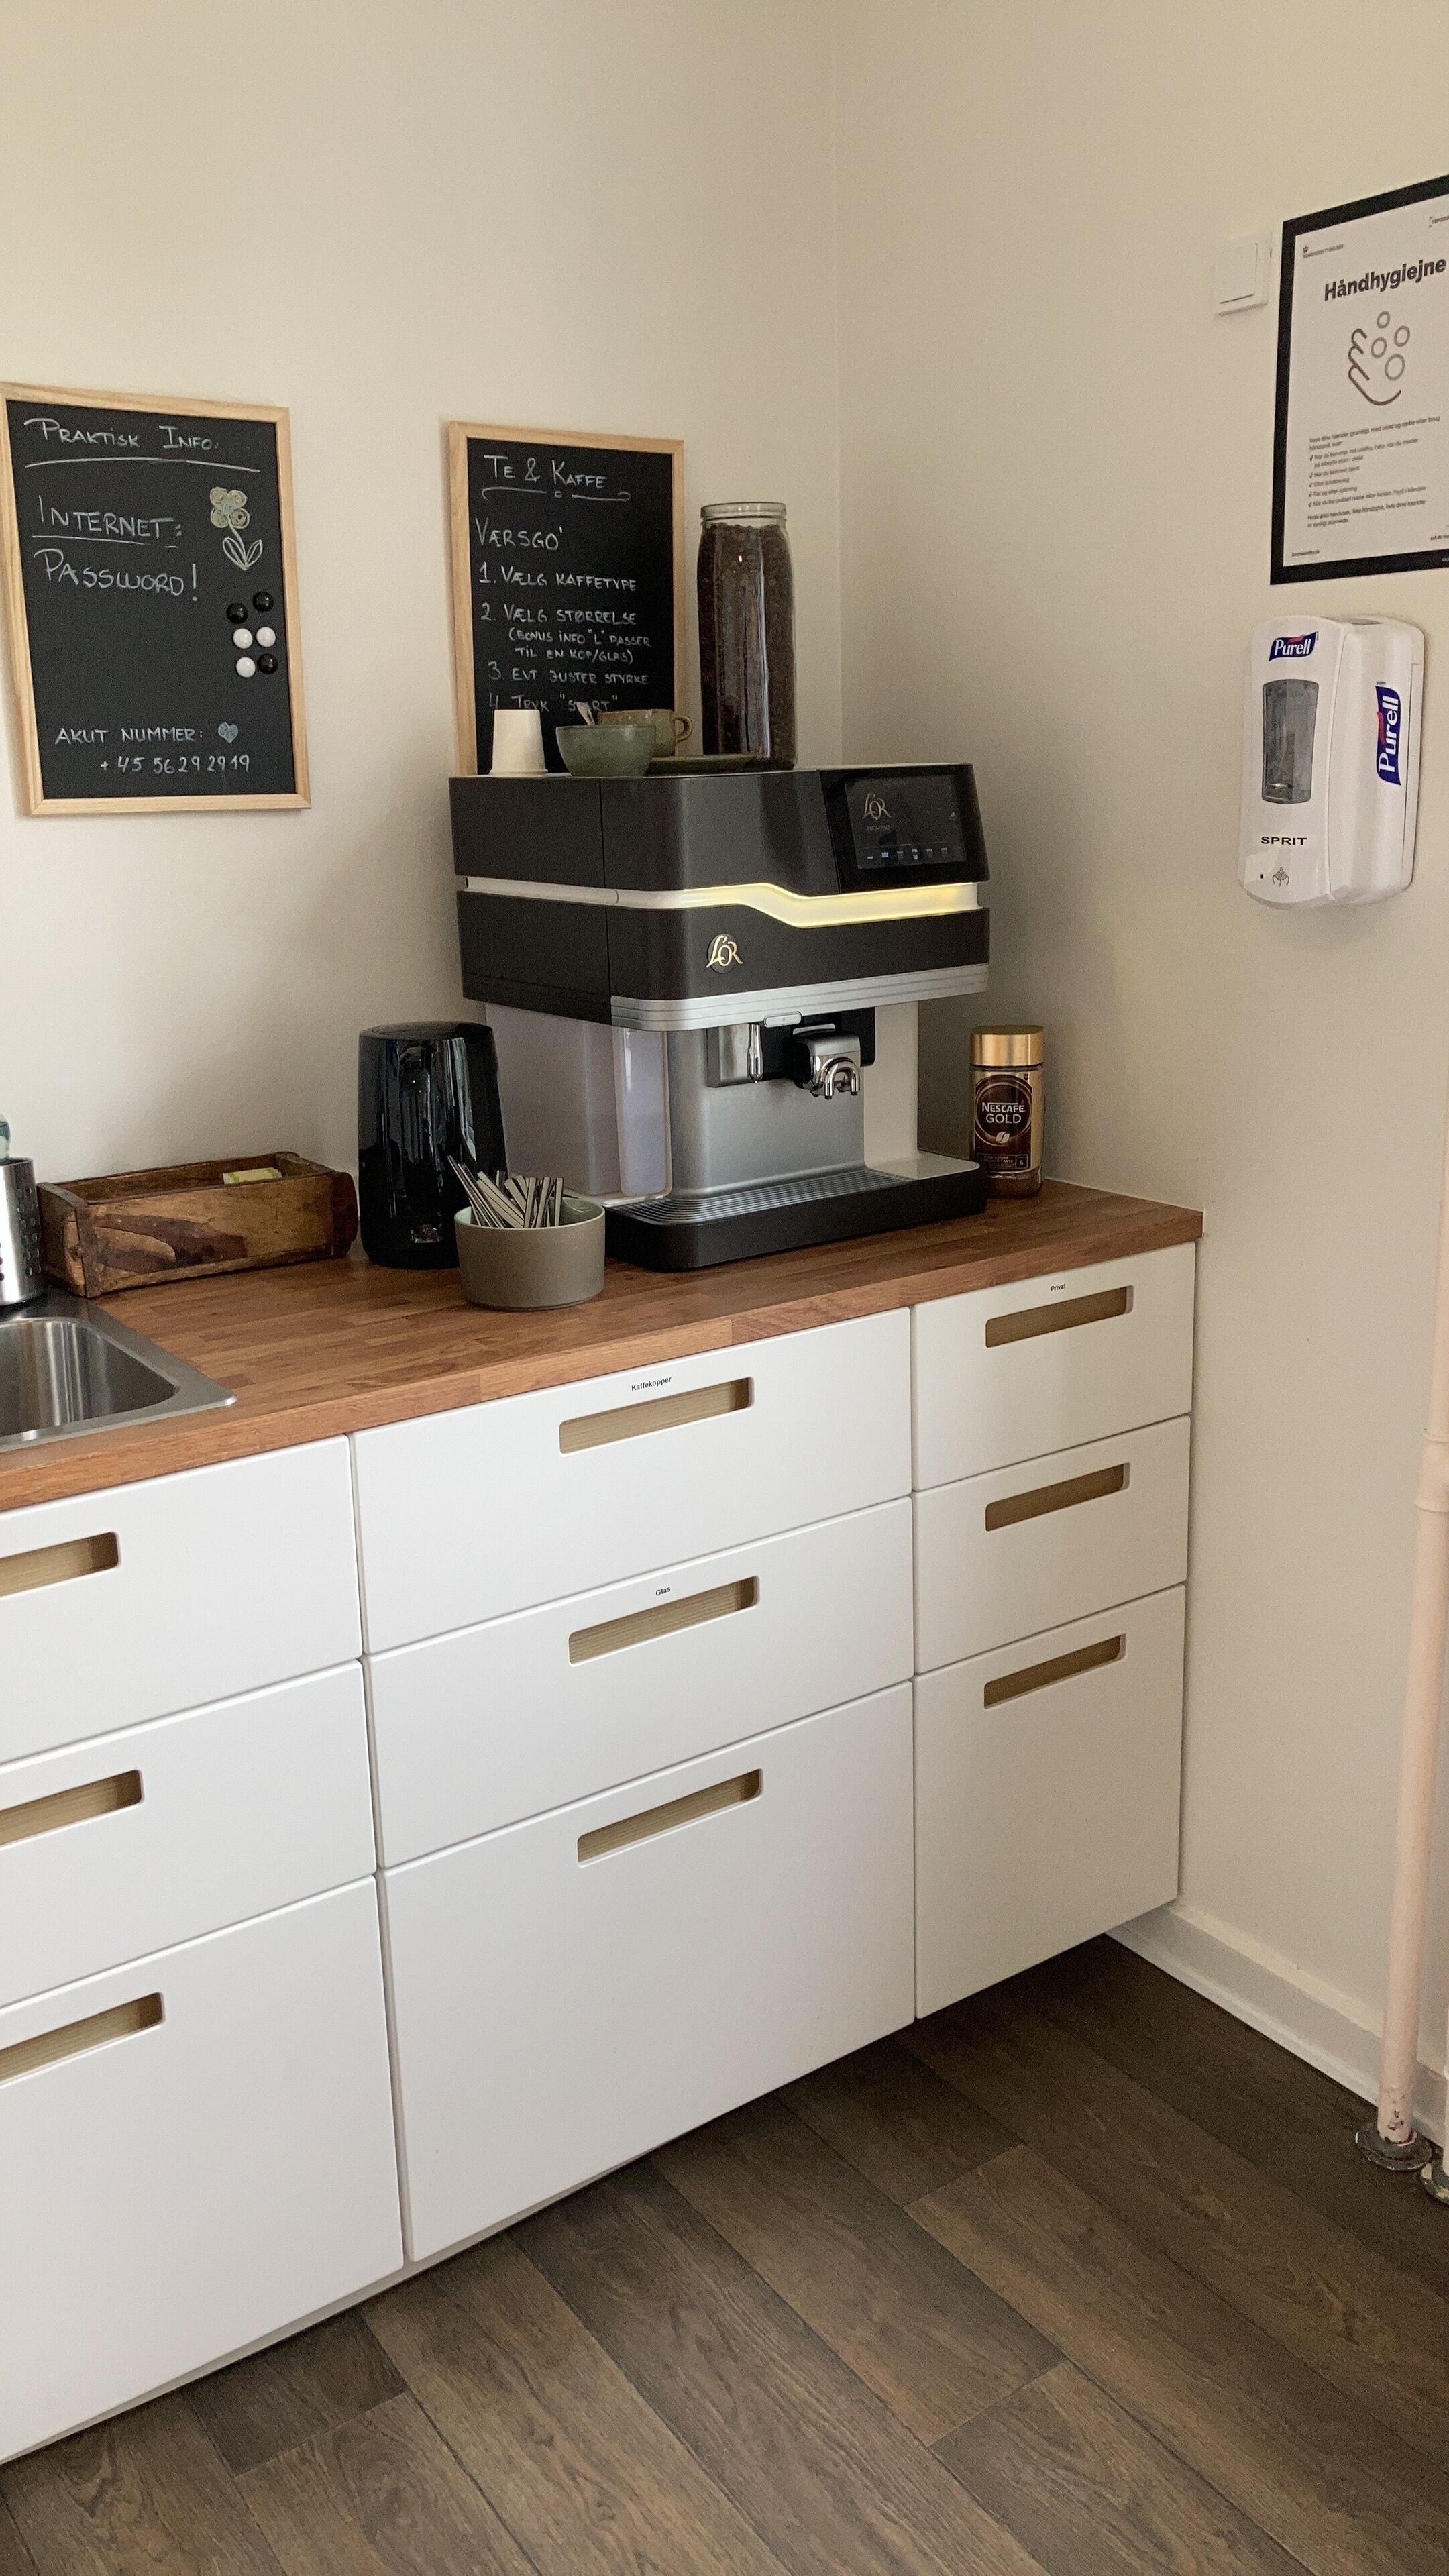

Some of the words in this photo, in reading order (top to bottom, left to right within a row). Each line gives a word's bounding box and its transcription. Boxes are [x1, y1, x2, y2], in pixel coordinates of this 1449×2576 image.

[1324, 258, 1447, 301] Håndhygiejne
[24, 418, 140, 447] PRAKTISK
[483, 454, 516, 478] TE
[525, 457, 541, 482] &
[551, 459, 608, 490] KAFFE
[501, 565, 548, 586] VÆLG
[555, 573, 637, 592] KAFFETYPE
[504, 604, 548, 623] VÆLG
[556, 609, 637, 625] STØRRELSE
[609, 635, 653, 648] PASSER
[1274, 639, 1312, 656] Purell
[515, 645, 537, 658] TIL
[546, 649, 564, 660] EN
[512, 667, 538, 681] EVT
[549, 669, 598, 684] JUSTER
[604, 673, 649, 686] STYRKE
[55, 728, 109, 745] AKUT
[1379, 695, 1399, 772] Purell
[1260, 836, 1307, 846] SPRIT
[986, 1114, 1022, 1124] GOLD
[1051, 1283, 1066, 1291] Privat
[631, 1376, 672, 1391] Kaffekopper
[655, 1586, 671, 1596] Glas
